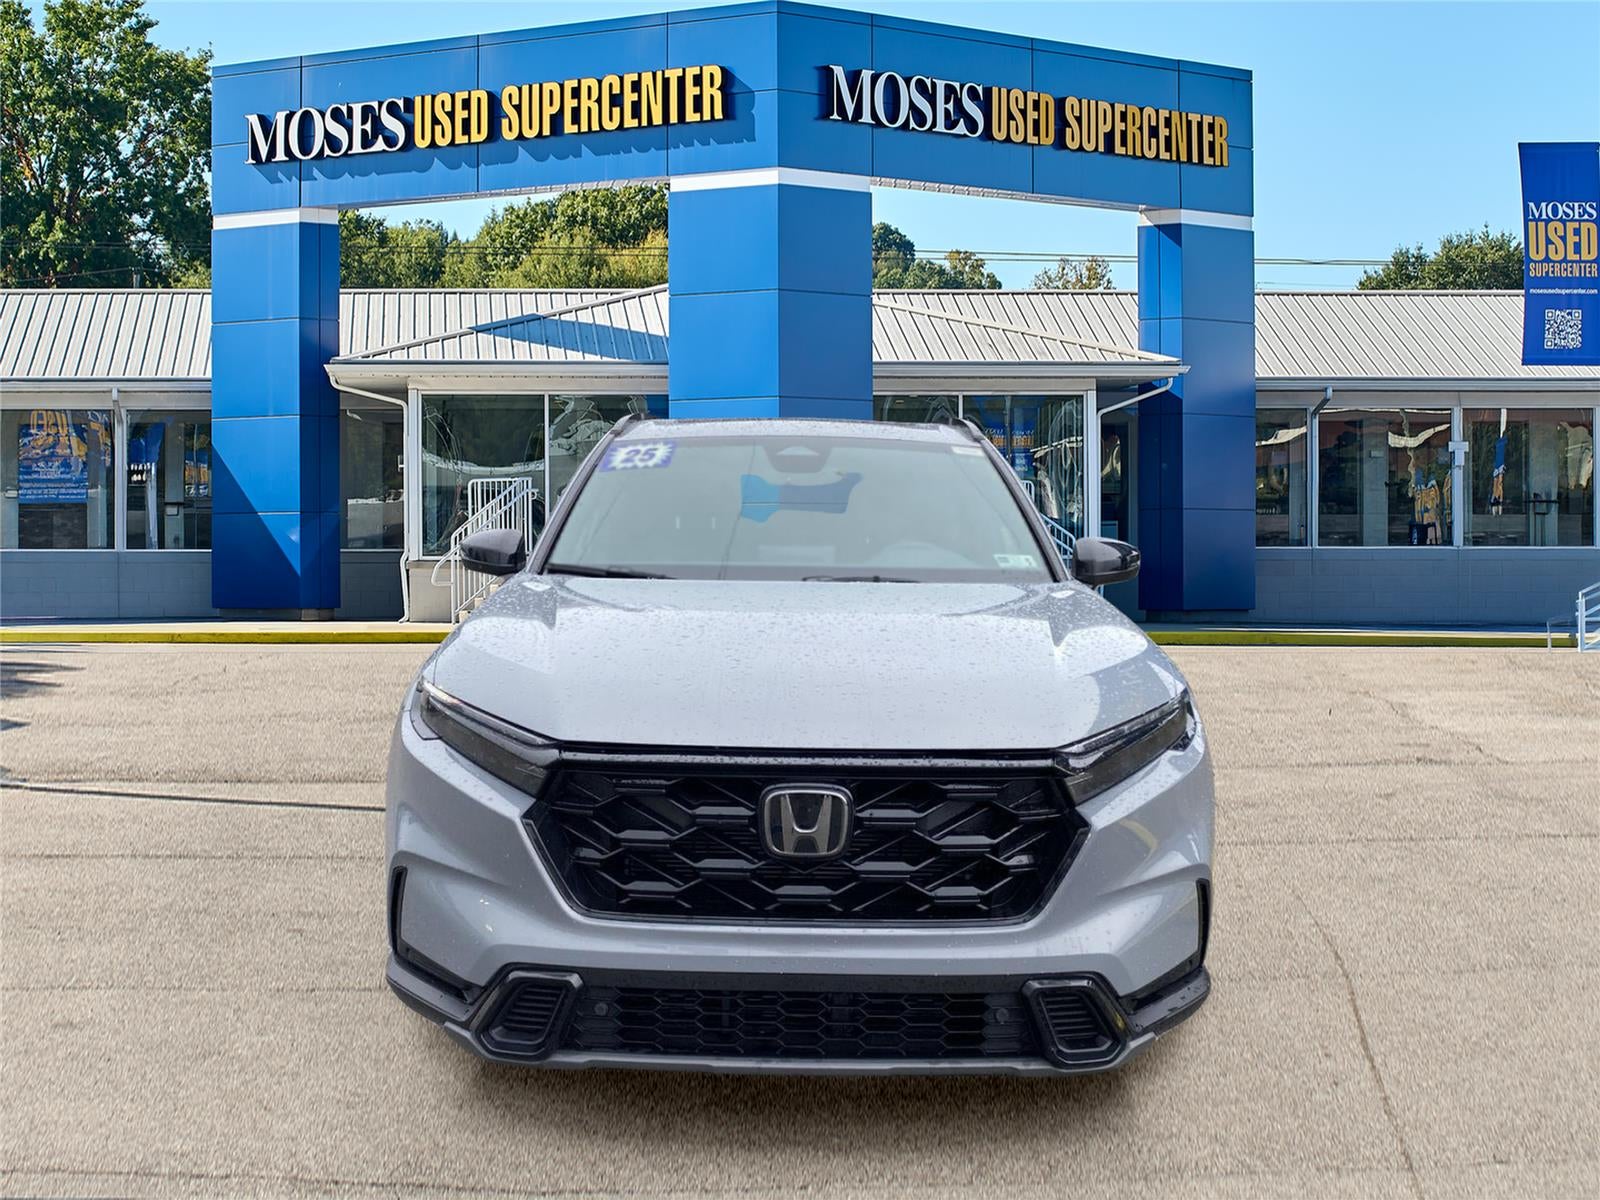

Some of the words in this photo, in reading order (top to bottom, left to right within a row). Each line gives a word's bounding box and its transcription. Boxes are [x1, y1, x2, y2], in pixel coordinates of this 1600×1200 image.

[245, 98, 406, 164] MOSES
[414, 89, 488, 149] USED
[501, 64, 723, 141] SUPERCENTER
[829, 64, 984, 137] MOSES
[992, 86, 1055, 145] USED
[1065, 96, 1229, 167] SUPERCENTER
[1528, 201, 1597, 220] MOSES
[1528, 221, 1598, 261] USED
[1529, 262, 1598, 277] SUPERCENTER
[620, 447, 659, 463] 25
